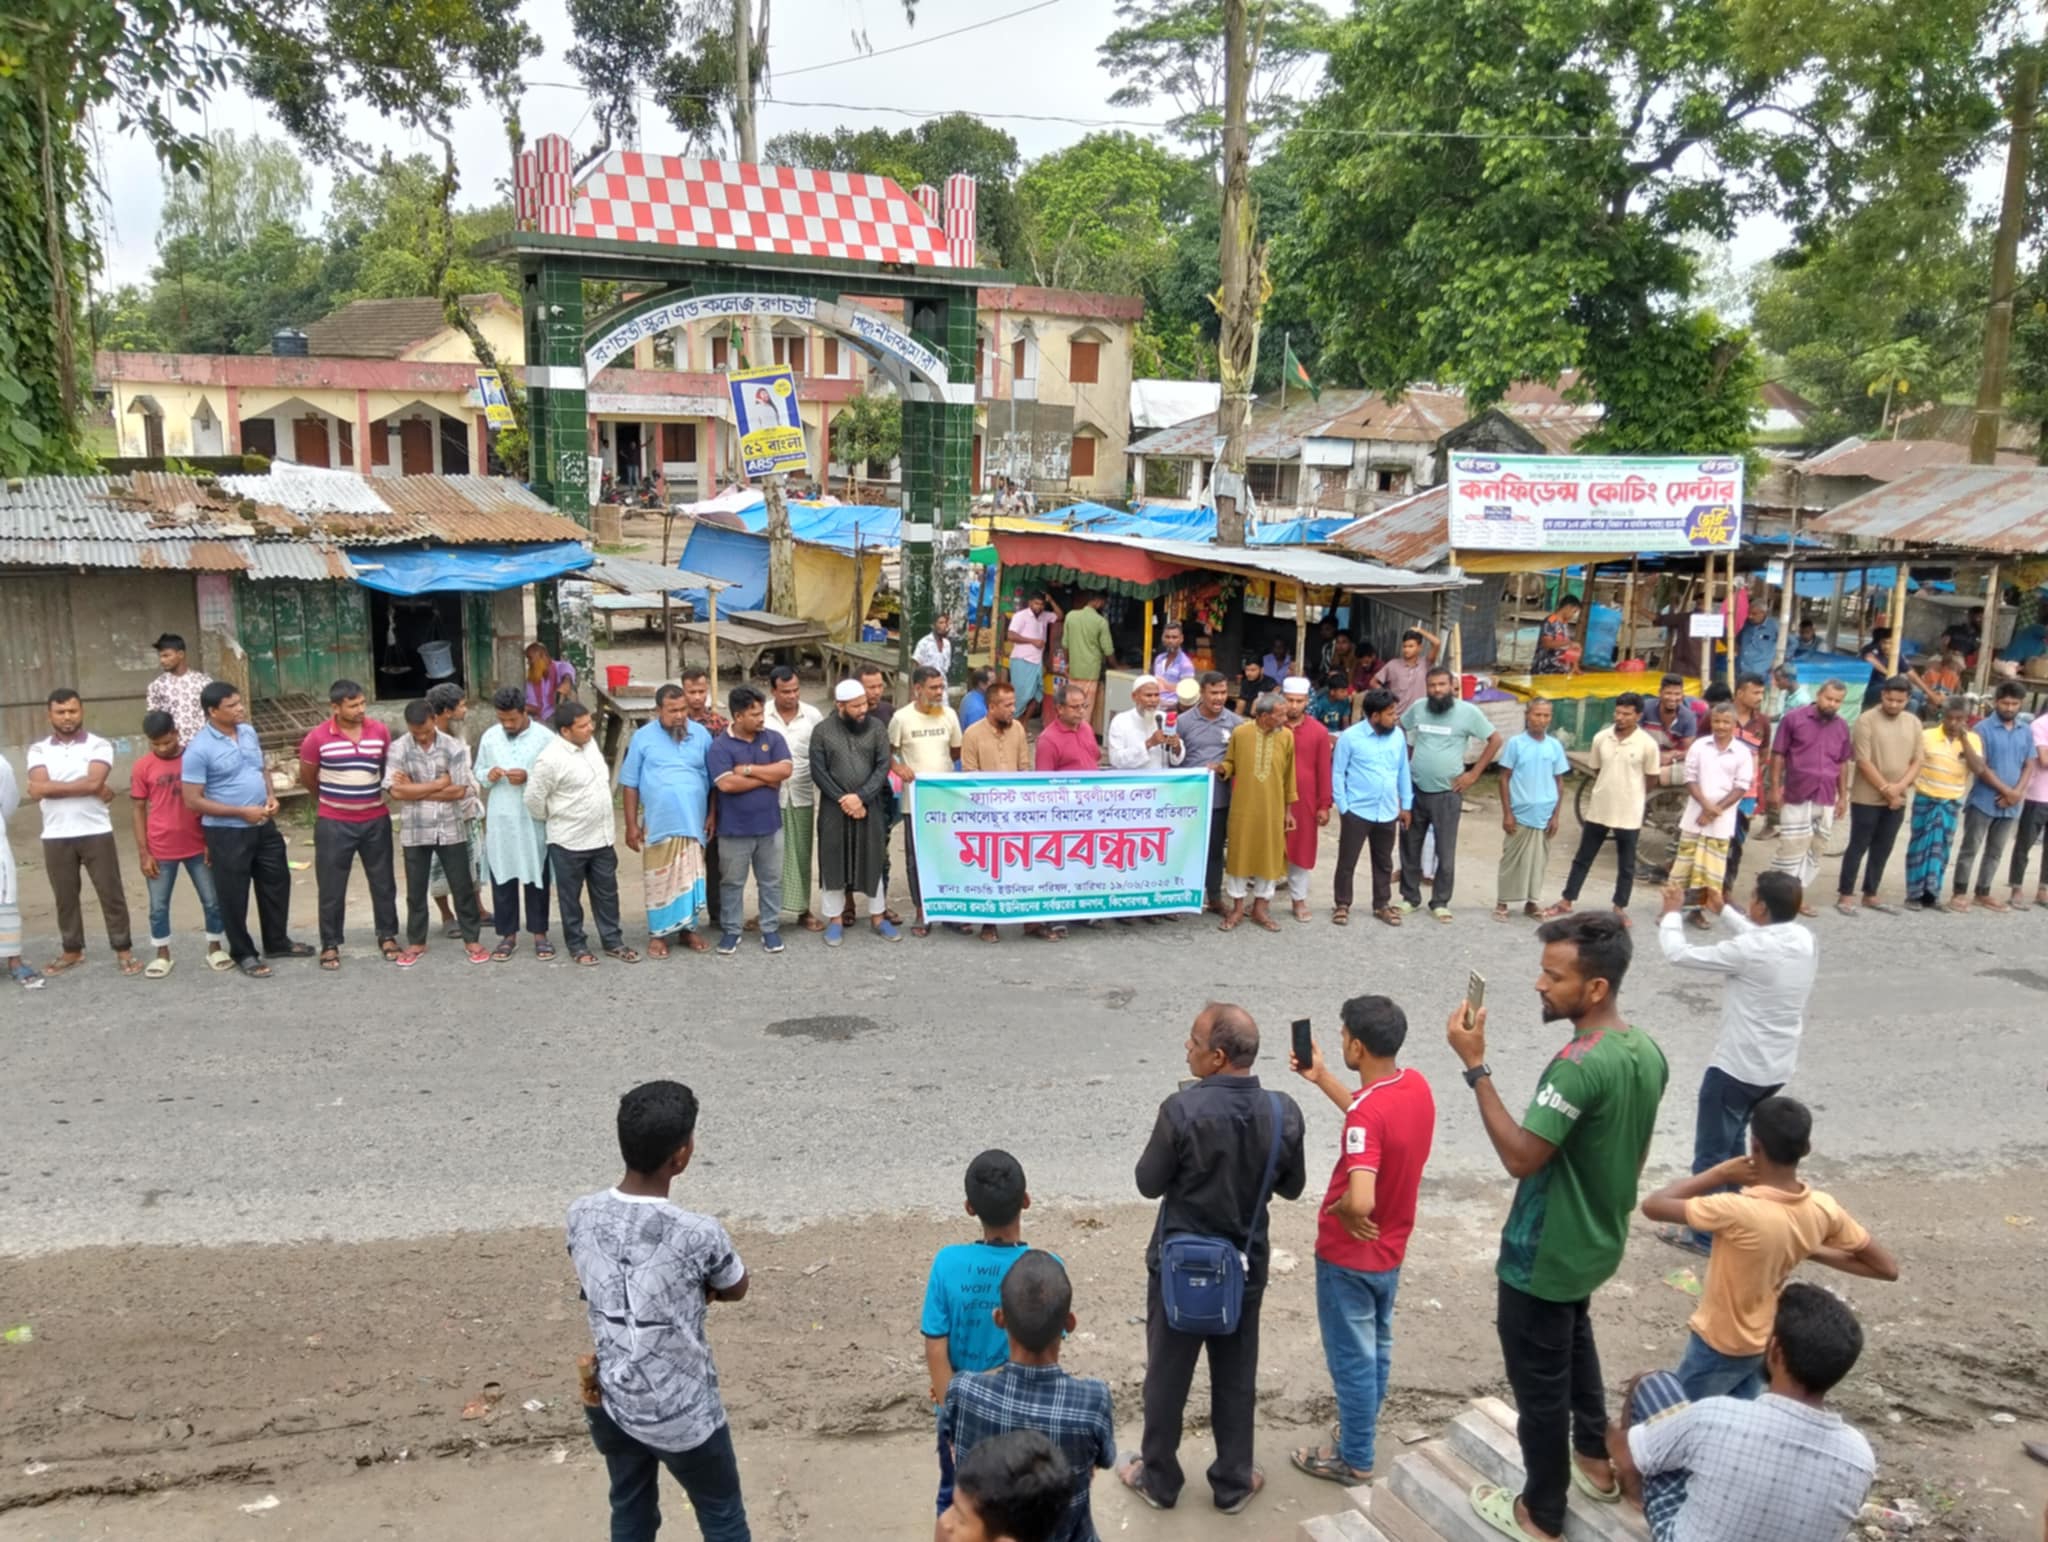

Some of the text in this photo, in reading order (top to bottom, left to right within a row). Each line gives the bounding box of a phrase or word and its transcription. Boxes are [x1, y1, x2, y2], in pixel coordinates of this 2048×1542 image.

[639, 309, 671, 332] স্কুল
[768, 437, 801, 452] বাংলা
[1458, 472, 1735, 506] কনফিডেন্স কোচিং সেন্টার
[970, 785, 1157, 805] ফ্যাসিস্ট আওয়ামী যুবলীগের নেতা
[925, 810, 946, 824] মোঃ
[1013, 810, 1047, 824] রহমান
[1051, 806, 1092, 823] বিমানের
[1155, 802, 1199, 818] প্রতিবাদে
[955, 827, 1173, 881] মানববন্ধন
[977, 1264, 1001, 1277] will
[961, 1283, 992, 1294] wait
